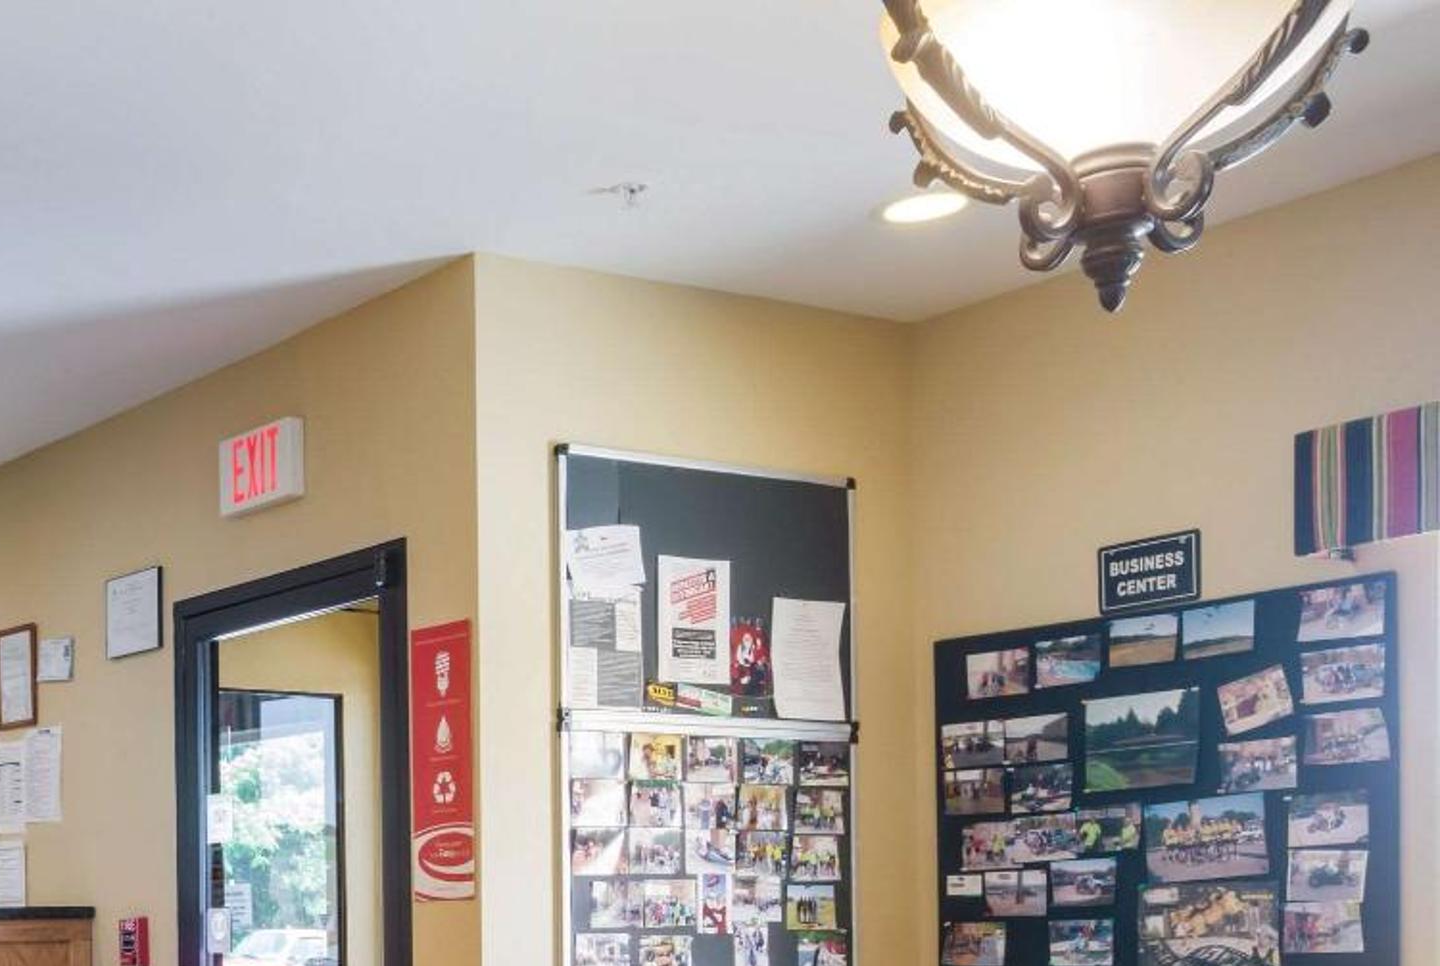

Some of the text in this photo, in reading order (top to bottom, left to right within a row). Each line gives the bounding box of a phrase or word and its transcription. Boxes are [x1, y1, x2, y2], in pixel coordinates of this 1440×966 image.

[232, 426, 280, 504] EXIT
[1109, 551, 1184, 577] BUSINESS
[1117, 574, 1176, 597] CENTER
